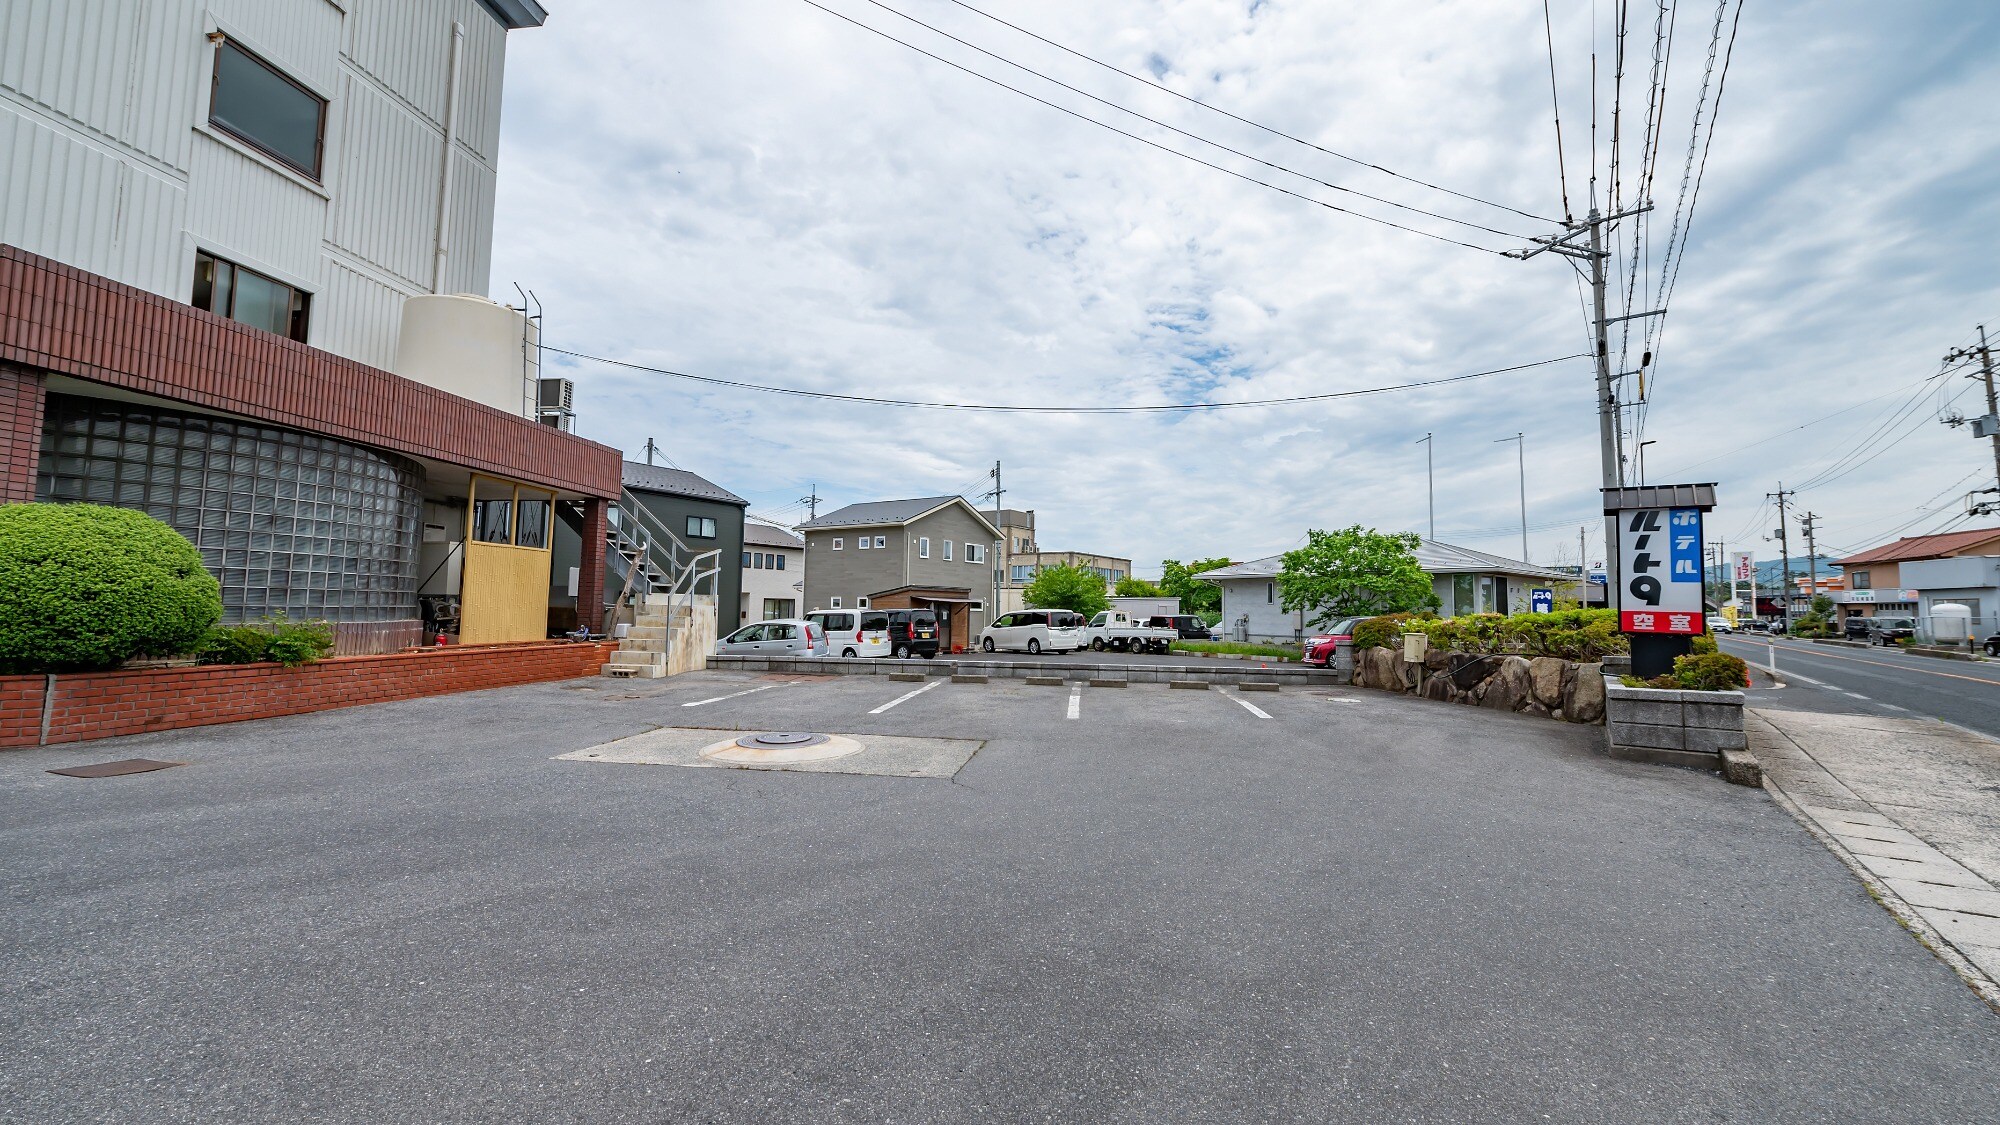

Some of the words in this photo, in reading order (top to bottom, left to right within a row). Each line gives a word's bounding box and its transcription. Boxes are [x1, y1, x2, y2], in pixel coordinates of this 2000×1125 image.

[1672, 511, 1698, 574] ホテル
[1633, 613, 1692, 632] 空室
